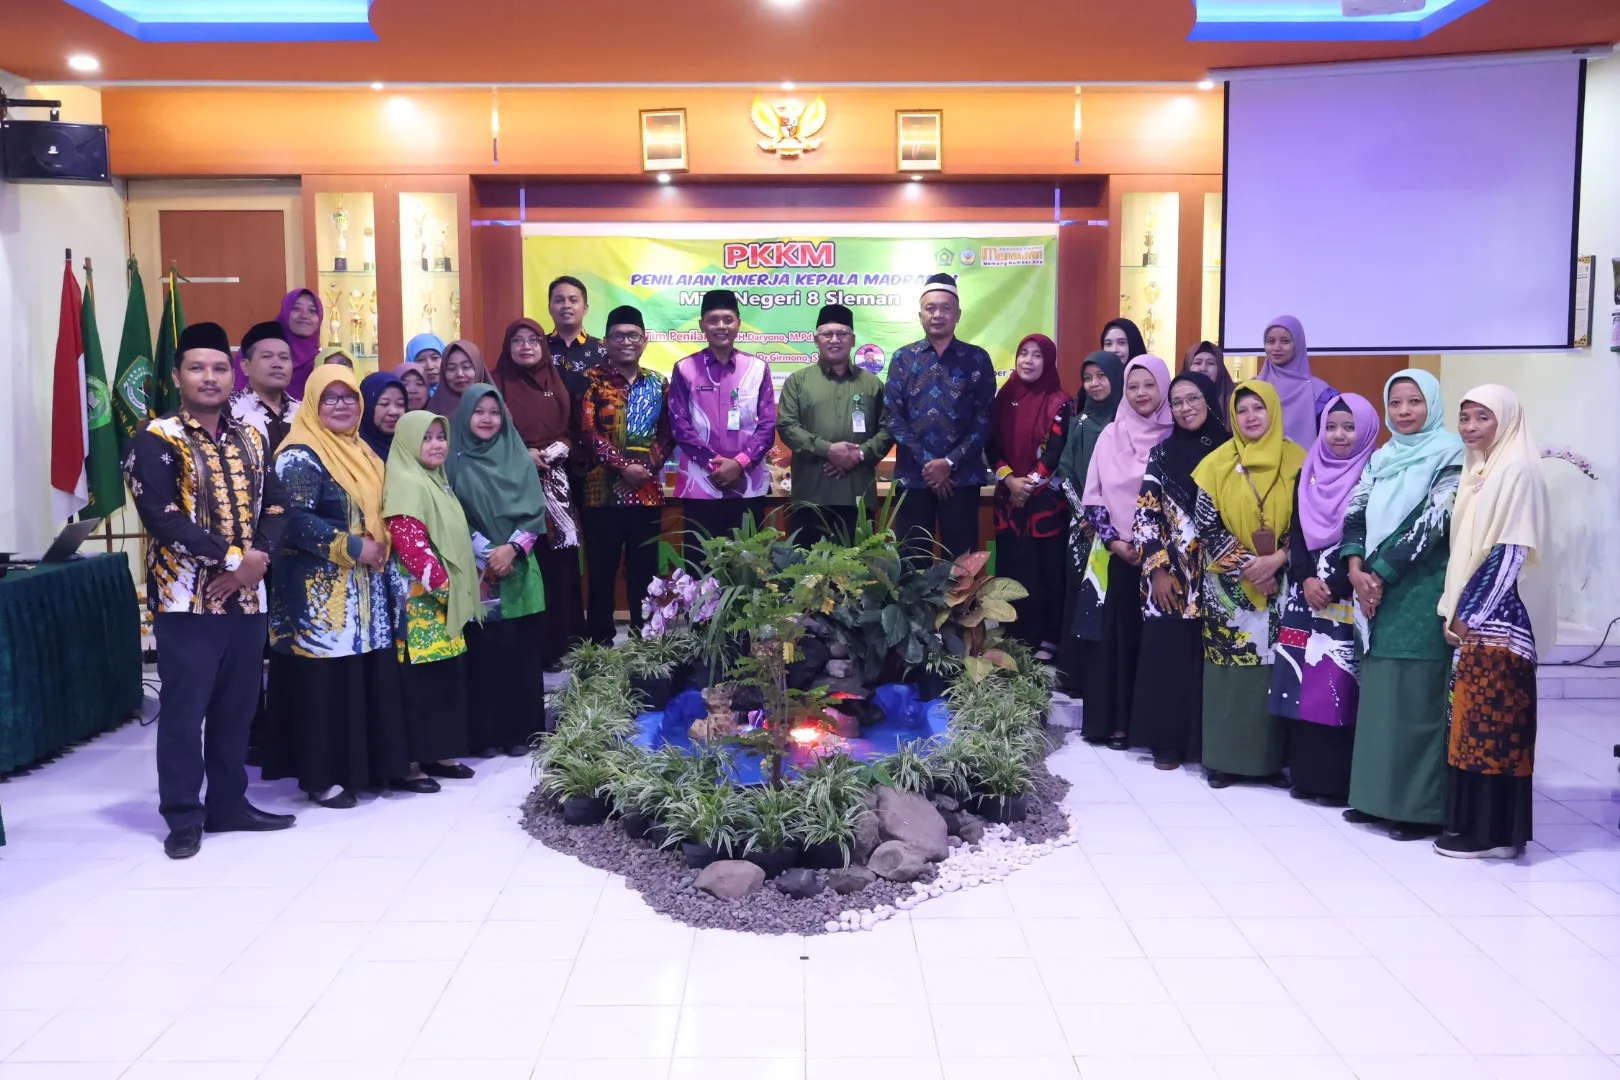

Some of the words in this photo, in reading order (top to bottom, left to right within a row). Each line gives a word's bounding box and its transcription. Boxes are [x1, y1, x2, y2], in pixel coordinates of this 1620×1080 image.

[725, 242, 835, 268] PKKM
[630, 274, 716, 286] PENILAIAN
[720, 274, 790, 286] KINERJA
[795, 273, 858, 286] KEPALA
[863, 273, 958, 286] MADRA
[733, 290, 800, 309] Negeri
[806, 290, 820, 306] 8
[825, 290, 901, 306] Sleman
[645, 329, 667, 342] Tim
